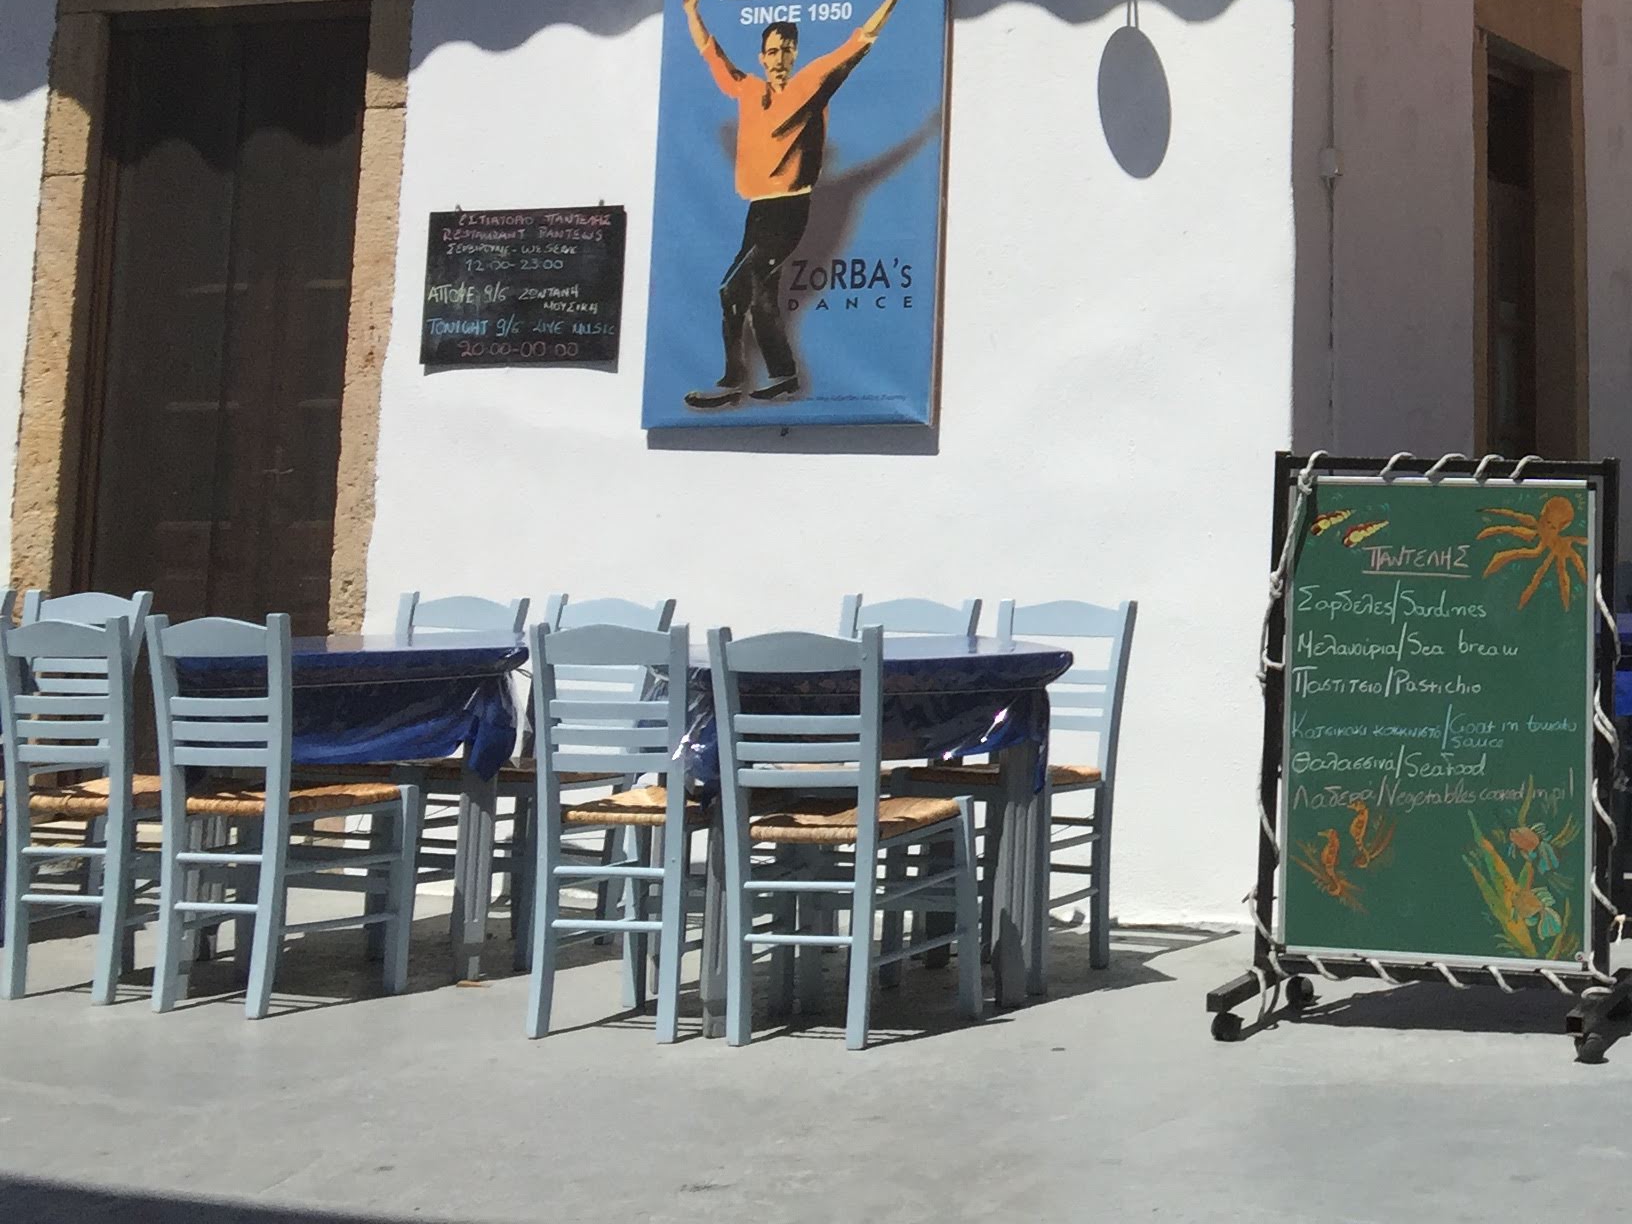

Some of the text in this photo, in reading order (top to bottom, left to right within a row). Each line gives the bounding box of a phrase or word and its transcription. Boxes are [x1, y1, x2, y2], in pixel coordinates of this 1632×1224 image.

[740, 2, 853, 25] SINCE 1950
[787, 296, 913, 311] DANCE
[426, 318, 488, 335] TONIGHT
[572, 324, 615, 335] MUSIC
[1501, 721, 1519, 732] in
